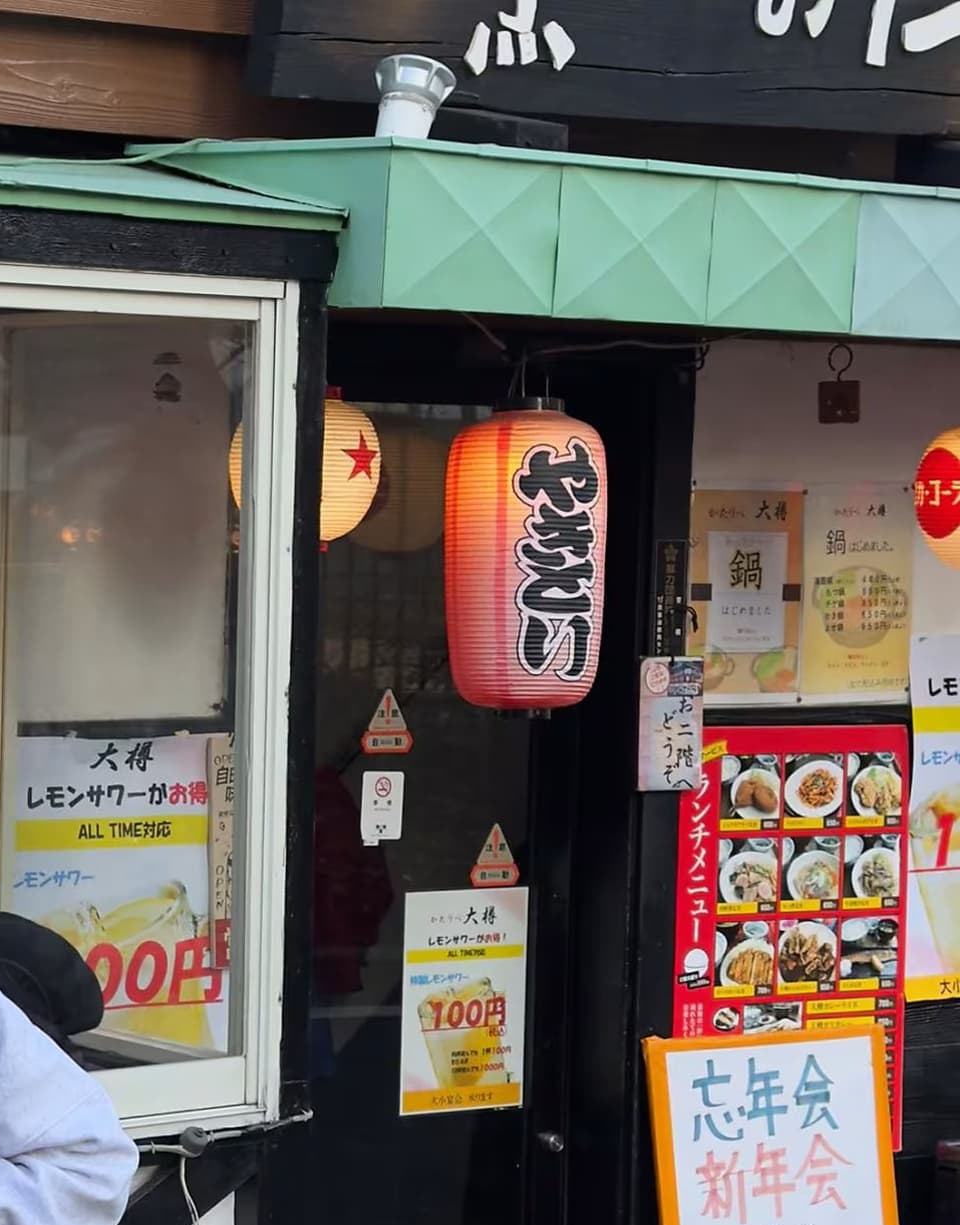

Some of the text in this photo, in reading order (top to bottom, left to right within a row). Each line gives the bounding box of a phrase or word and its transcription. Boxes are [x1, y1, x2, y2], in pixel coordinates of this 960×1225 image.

[513, 437, 601, 682] やきとり
[729, 549, 762, 590] 鍋
[826, 530, 846, 555] 鍋
[663, 710, 679, 784] どうぞ
[77, 820, 172, 840] ALL TIME対応
[687, 773, 711, 942] ランチメニュー
[432, 996, 506, 1030] 100円
[691, 1053, 839, 1142] 忘年会
[696, 1133, 855, 1224] 新年会
